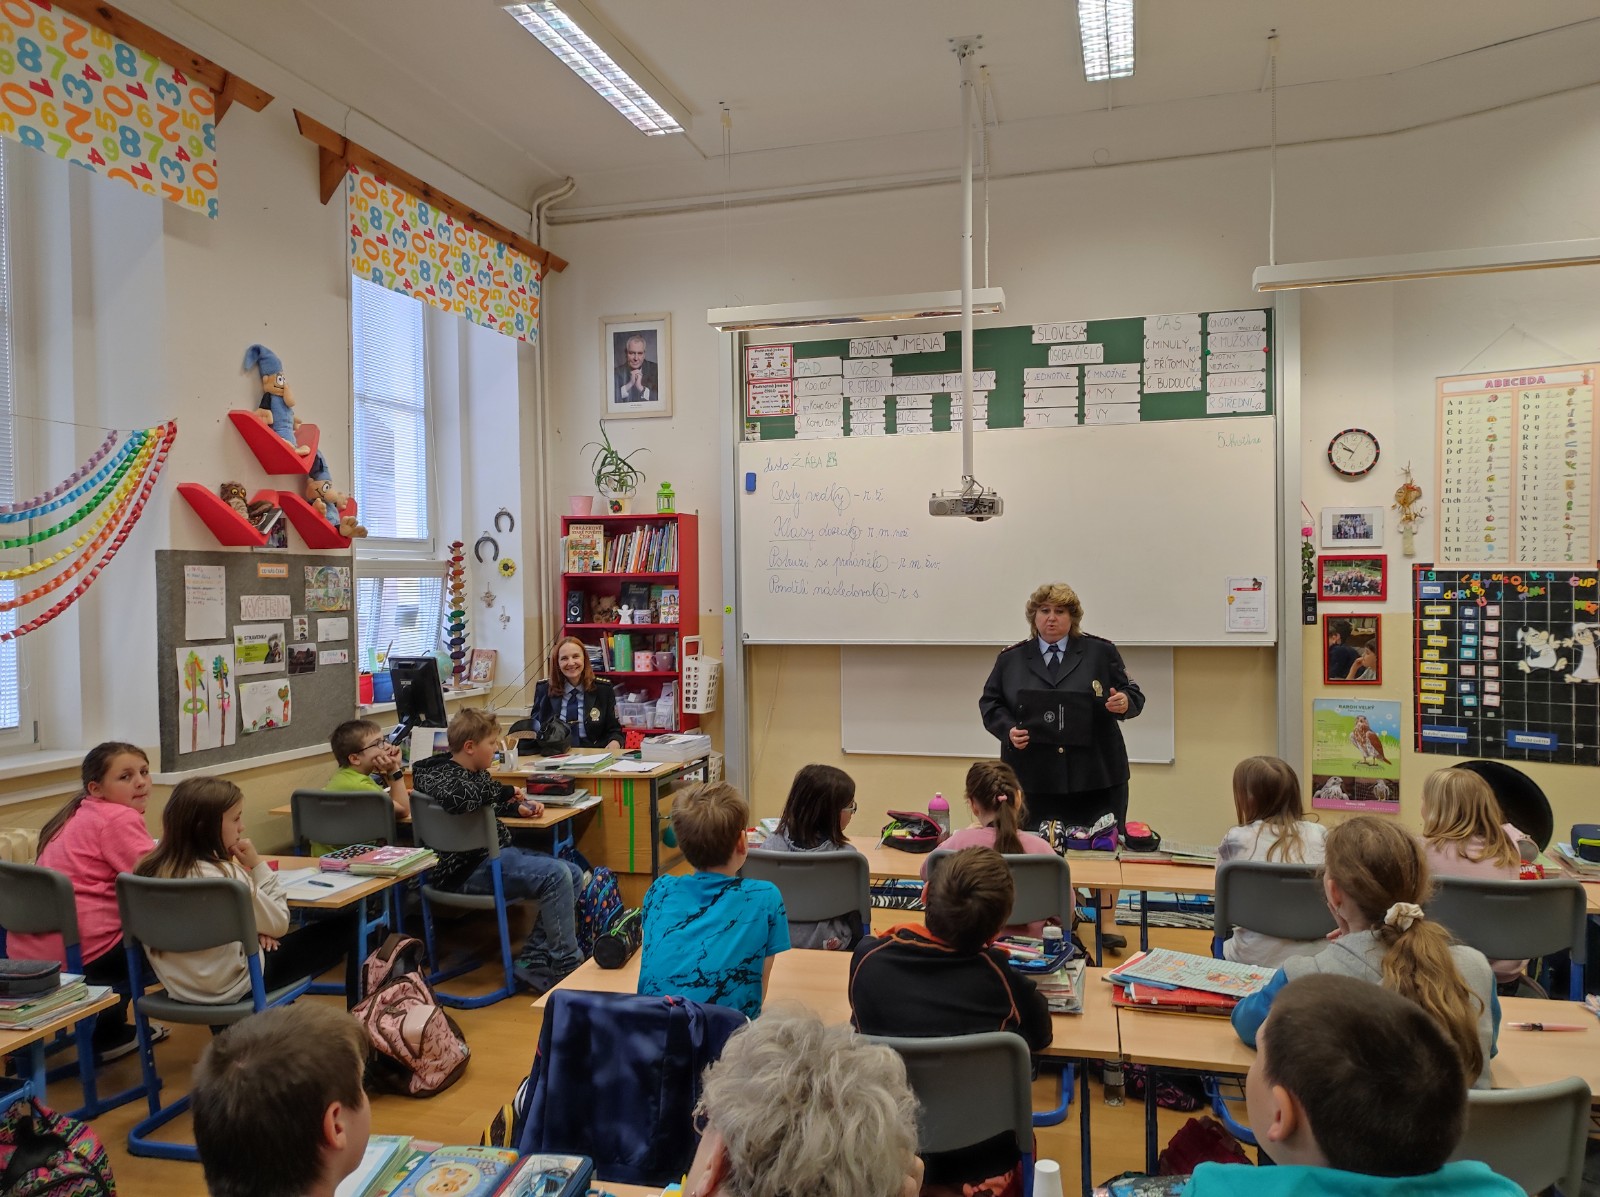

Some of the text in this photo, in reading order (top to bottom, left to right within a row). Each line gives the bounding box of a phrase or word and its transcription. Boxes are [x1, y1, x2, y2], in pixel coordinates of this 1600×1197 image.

[1038, 325, 1086, 341] SLOVESA
[901, 333, 942, 351] JMÉNA
[849, 361, 880, 375] VZOR
[1157, 374, 1197, 389] BUDOUCÍ
[1484, 375, 1546, 388] ABECEDA
[1097, 388, 1116, 400] MY
[1036, 413, 1051, 423] TY
[1096, 408, 1109, 420] VY
[791, 451, 822, 469] ŽÁBA
[774, 515, 815, 551] Klasy
[814, 558, 828, 568] se
[769, 574, 809, 595] Pondělí
